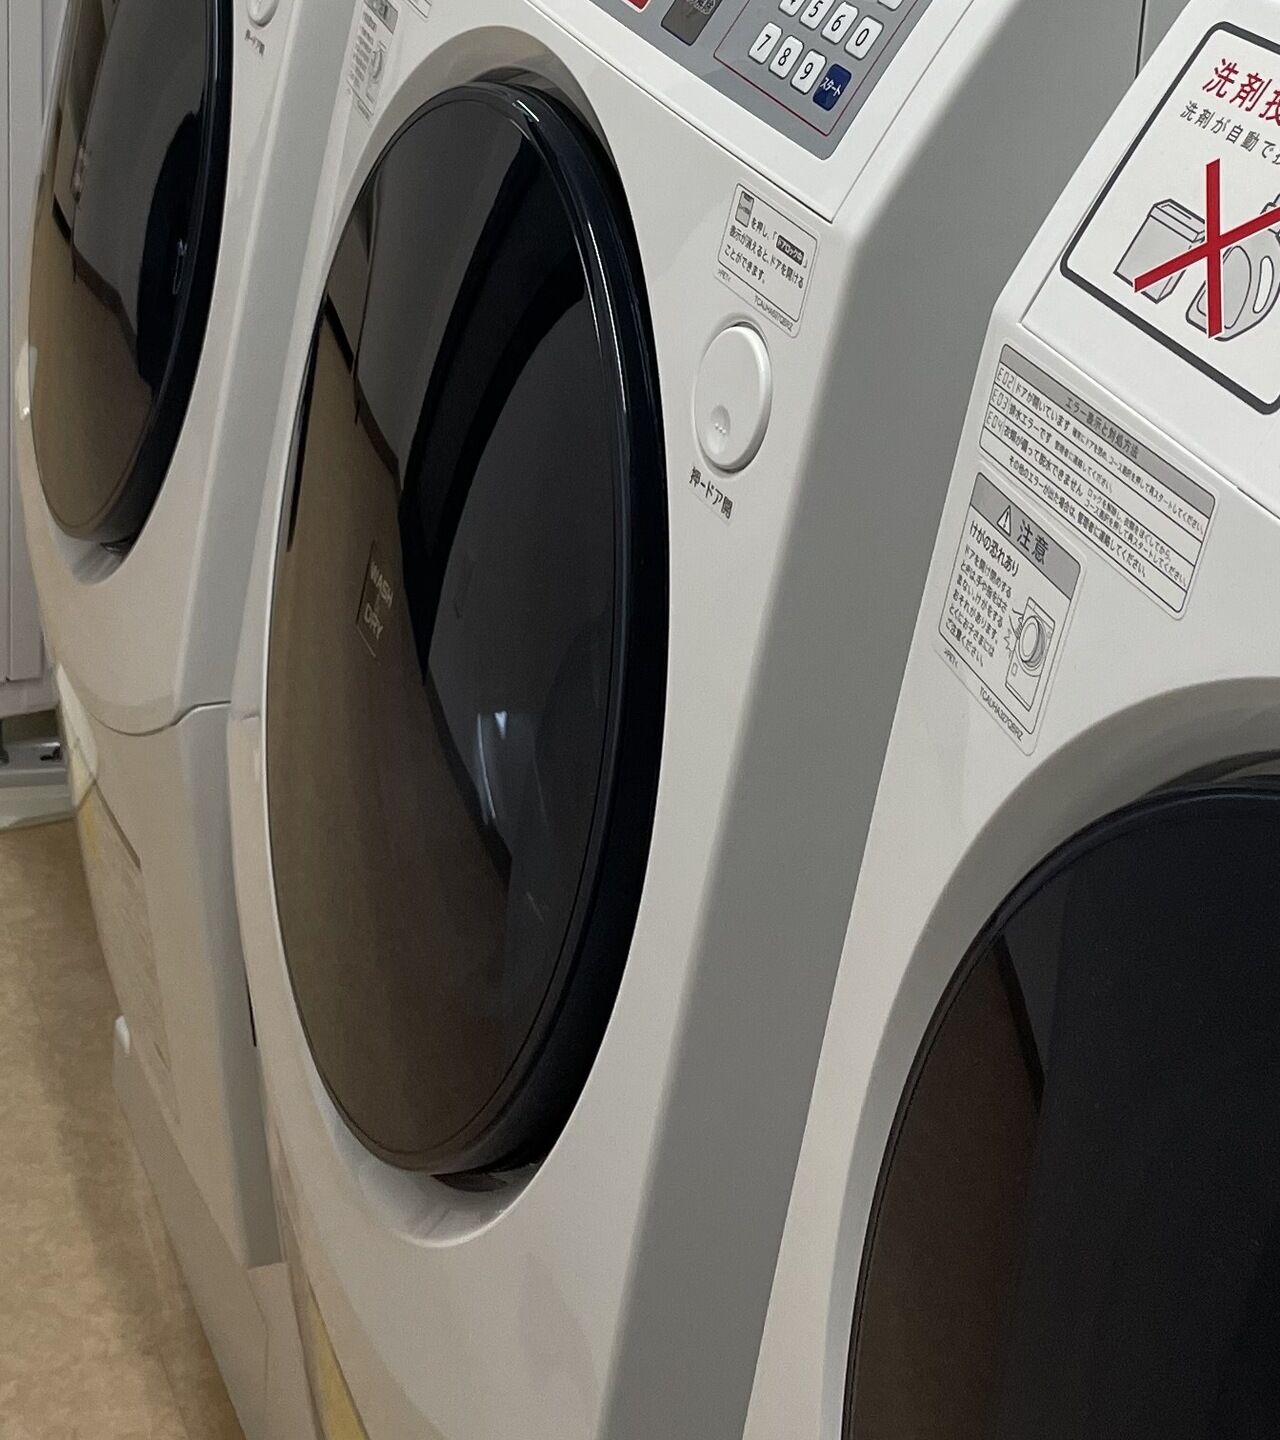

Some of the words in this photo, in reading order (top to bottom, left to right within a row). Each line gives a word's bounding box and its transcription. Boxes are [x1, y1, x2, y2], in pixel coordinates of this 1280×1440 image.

[808, 0, 825, 18] 5
[830, 13, 847, 31] 6
[756, 33, 772, 53] 7
[855, 27, 871, 47] 0
[779, 47, 793, 67] 8
[800, 62, 815, 81] 9
[819, 77, 842, 98] スタート
[969, 520, 1020, 578] けがの恐れあり
[1018, 518, 1049, 565] 注意
